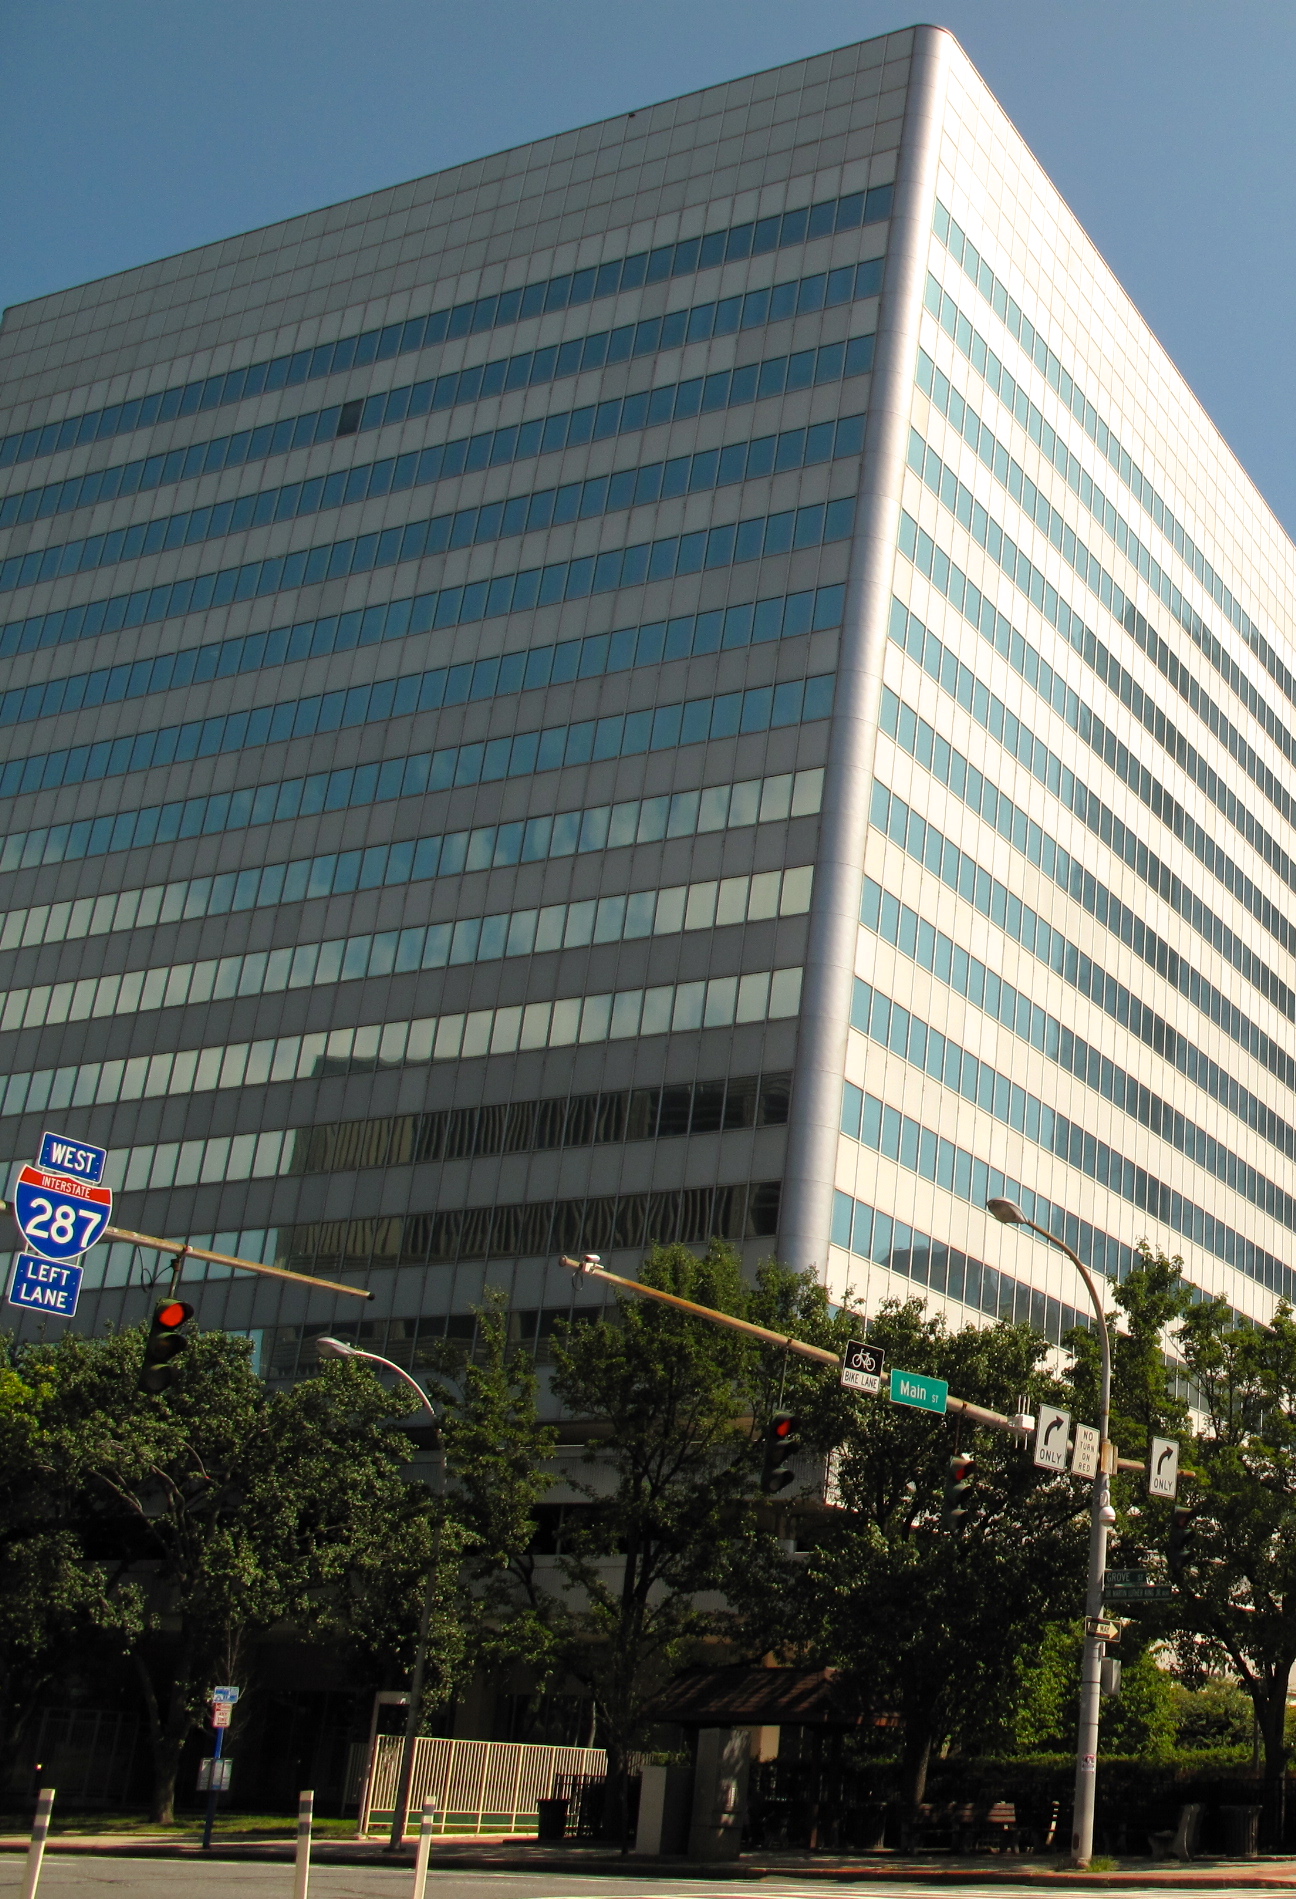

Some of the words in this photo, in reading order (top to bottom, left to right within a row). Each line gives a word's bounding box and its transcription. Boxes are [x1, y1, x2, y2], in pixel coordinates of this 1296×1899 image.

[52, 1142, 96, 1173] WEST
[41, 1175, 91, 1199] INTERSTATE
[26, 1197, 102, 1248] 287
[27, 1262, 70, 1286] LEFT
[20, 1283, 68, 1308] LANE
[845, 1371, 859, 1384] BIKE
[861, 1376, 877, 1389] LANE
[900, 1380, 926, 1400] Main
[932, 1394, 939, 1403] ST
[1083, 1430, 1093, 1441] NO
[1080, 1441, 1095, 1453] TURN
[1040, 1448, 1062, 1464] ONLY
[1082, 1452, 1090, 1461] ON
[1078, 1462, 1091, 1472] RED
[1154, 1478, 1173, 1491] ONLY
[1106, 1572, 1130, 1582] GROVE
